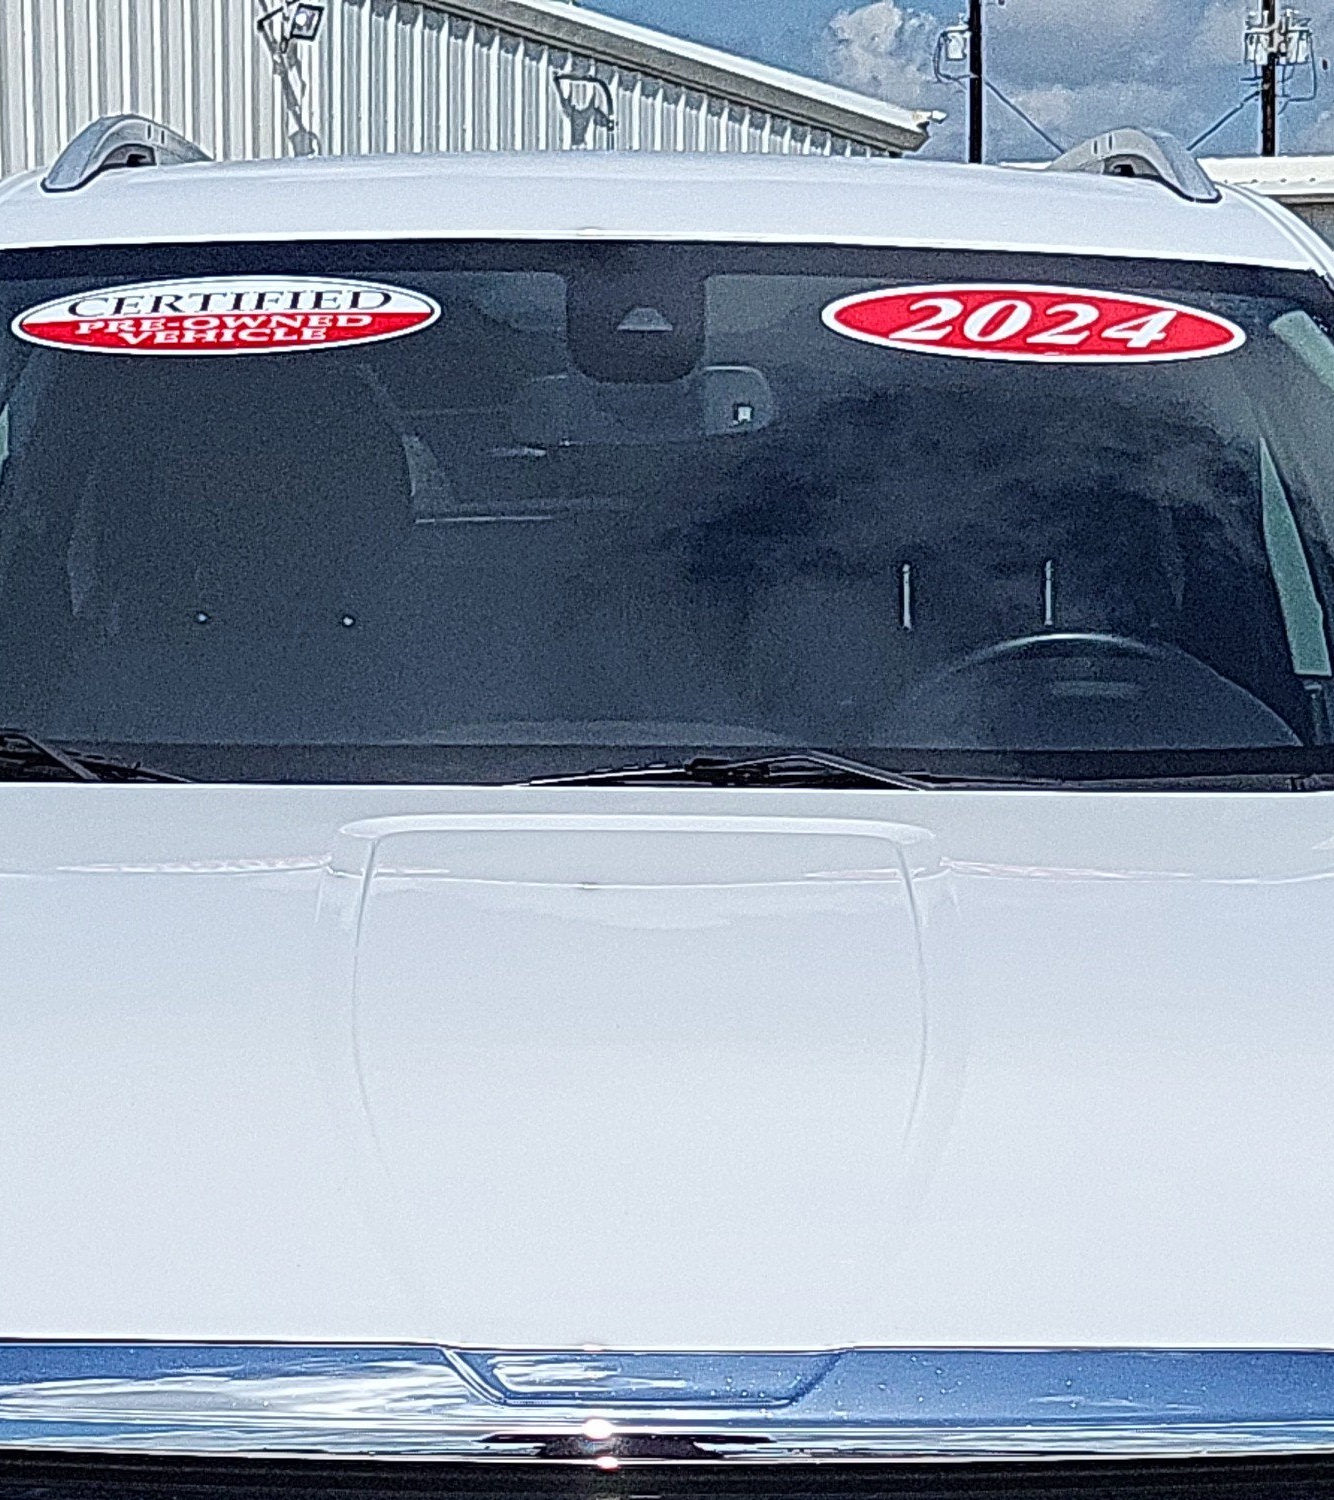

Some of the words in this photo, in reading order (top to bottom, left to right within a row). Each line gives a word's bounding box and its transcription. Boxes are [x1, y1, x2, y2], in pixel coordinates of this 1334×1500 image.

[68, 289, 392, 317] CERTIFIED
[74, 315, 373, 336] PRE-OWNED
[889, 297, 1178, 348] 2024
[118, 328, 327, 345] VEHICLE
